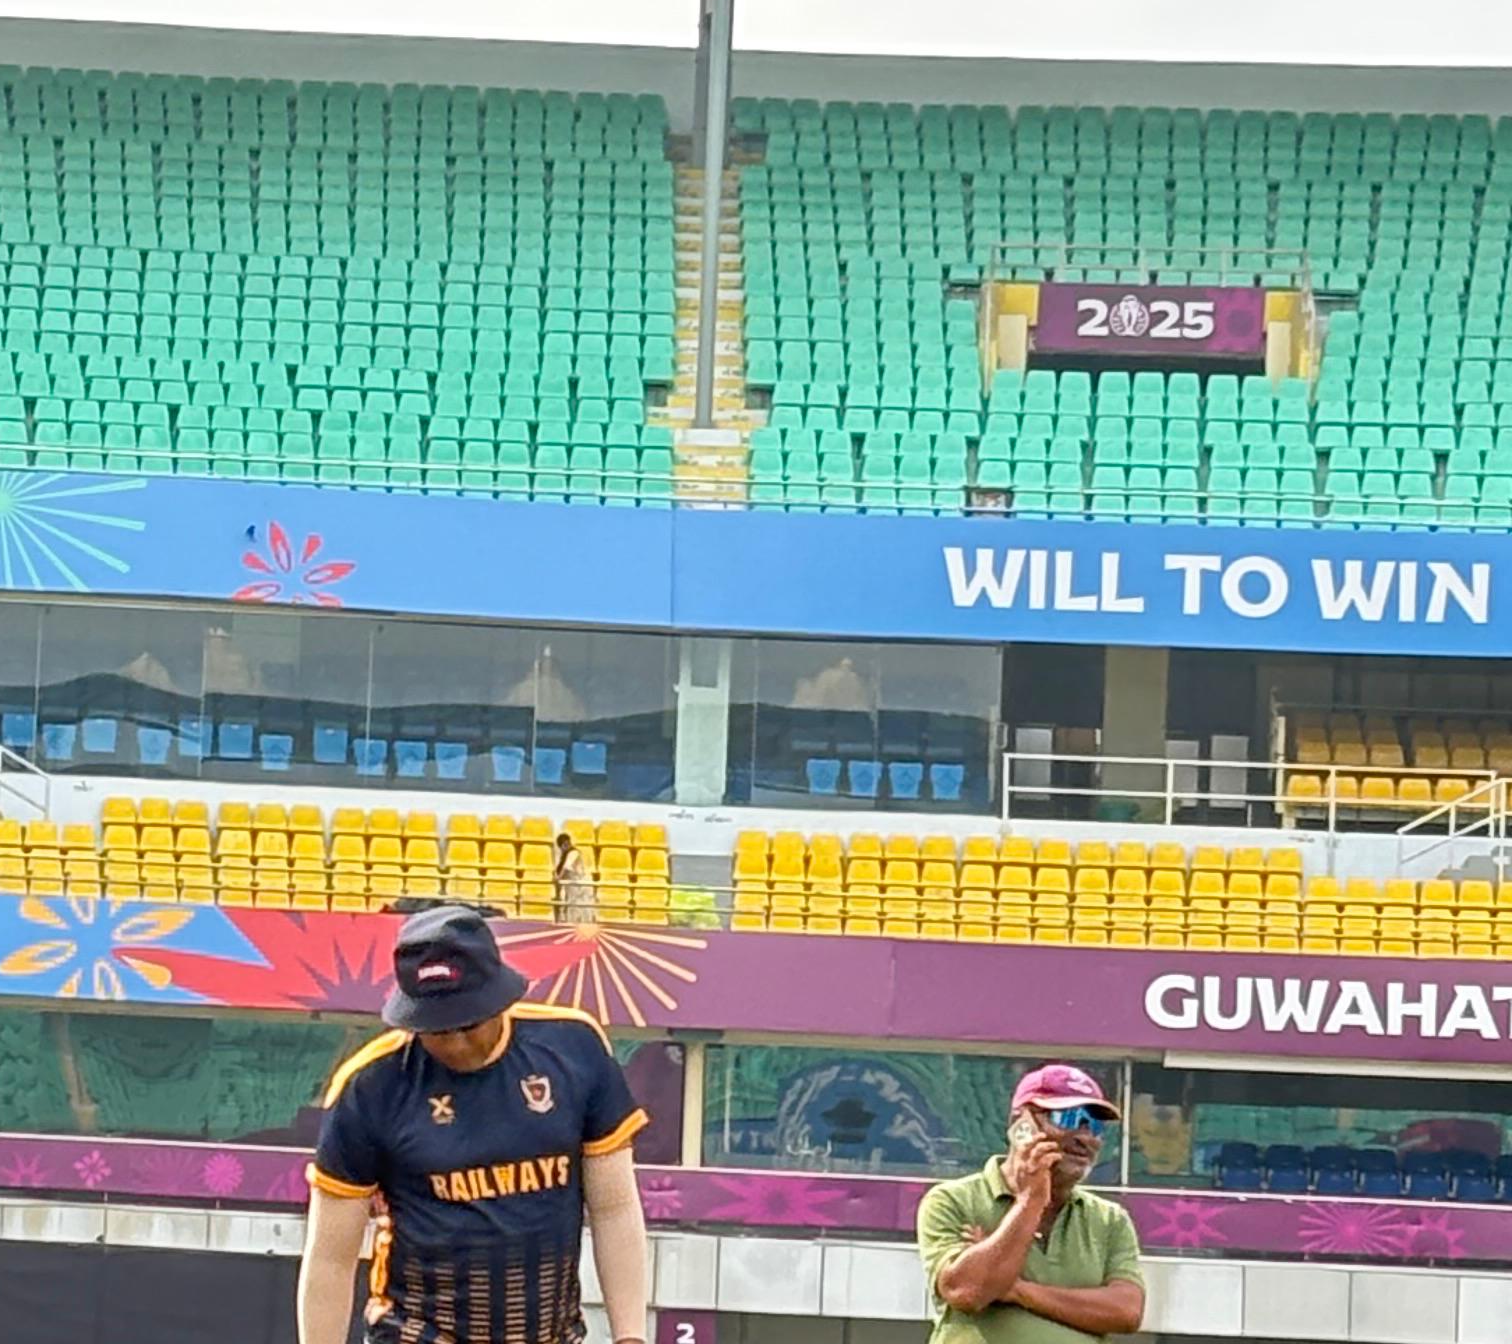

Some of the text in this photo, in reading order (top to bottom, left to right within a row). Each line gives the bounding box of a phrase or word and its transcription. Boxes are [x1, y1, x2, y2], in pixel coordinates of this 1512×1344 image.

[943, 546, 1490, 624] WILL TO WIN
[429, 1155, 570, 1202] RAILWAYS
